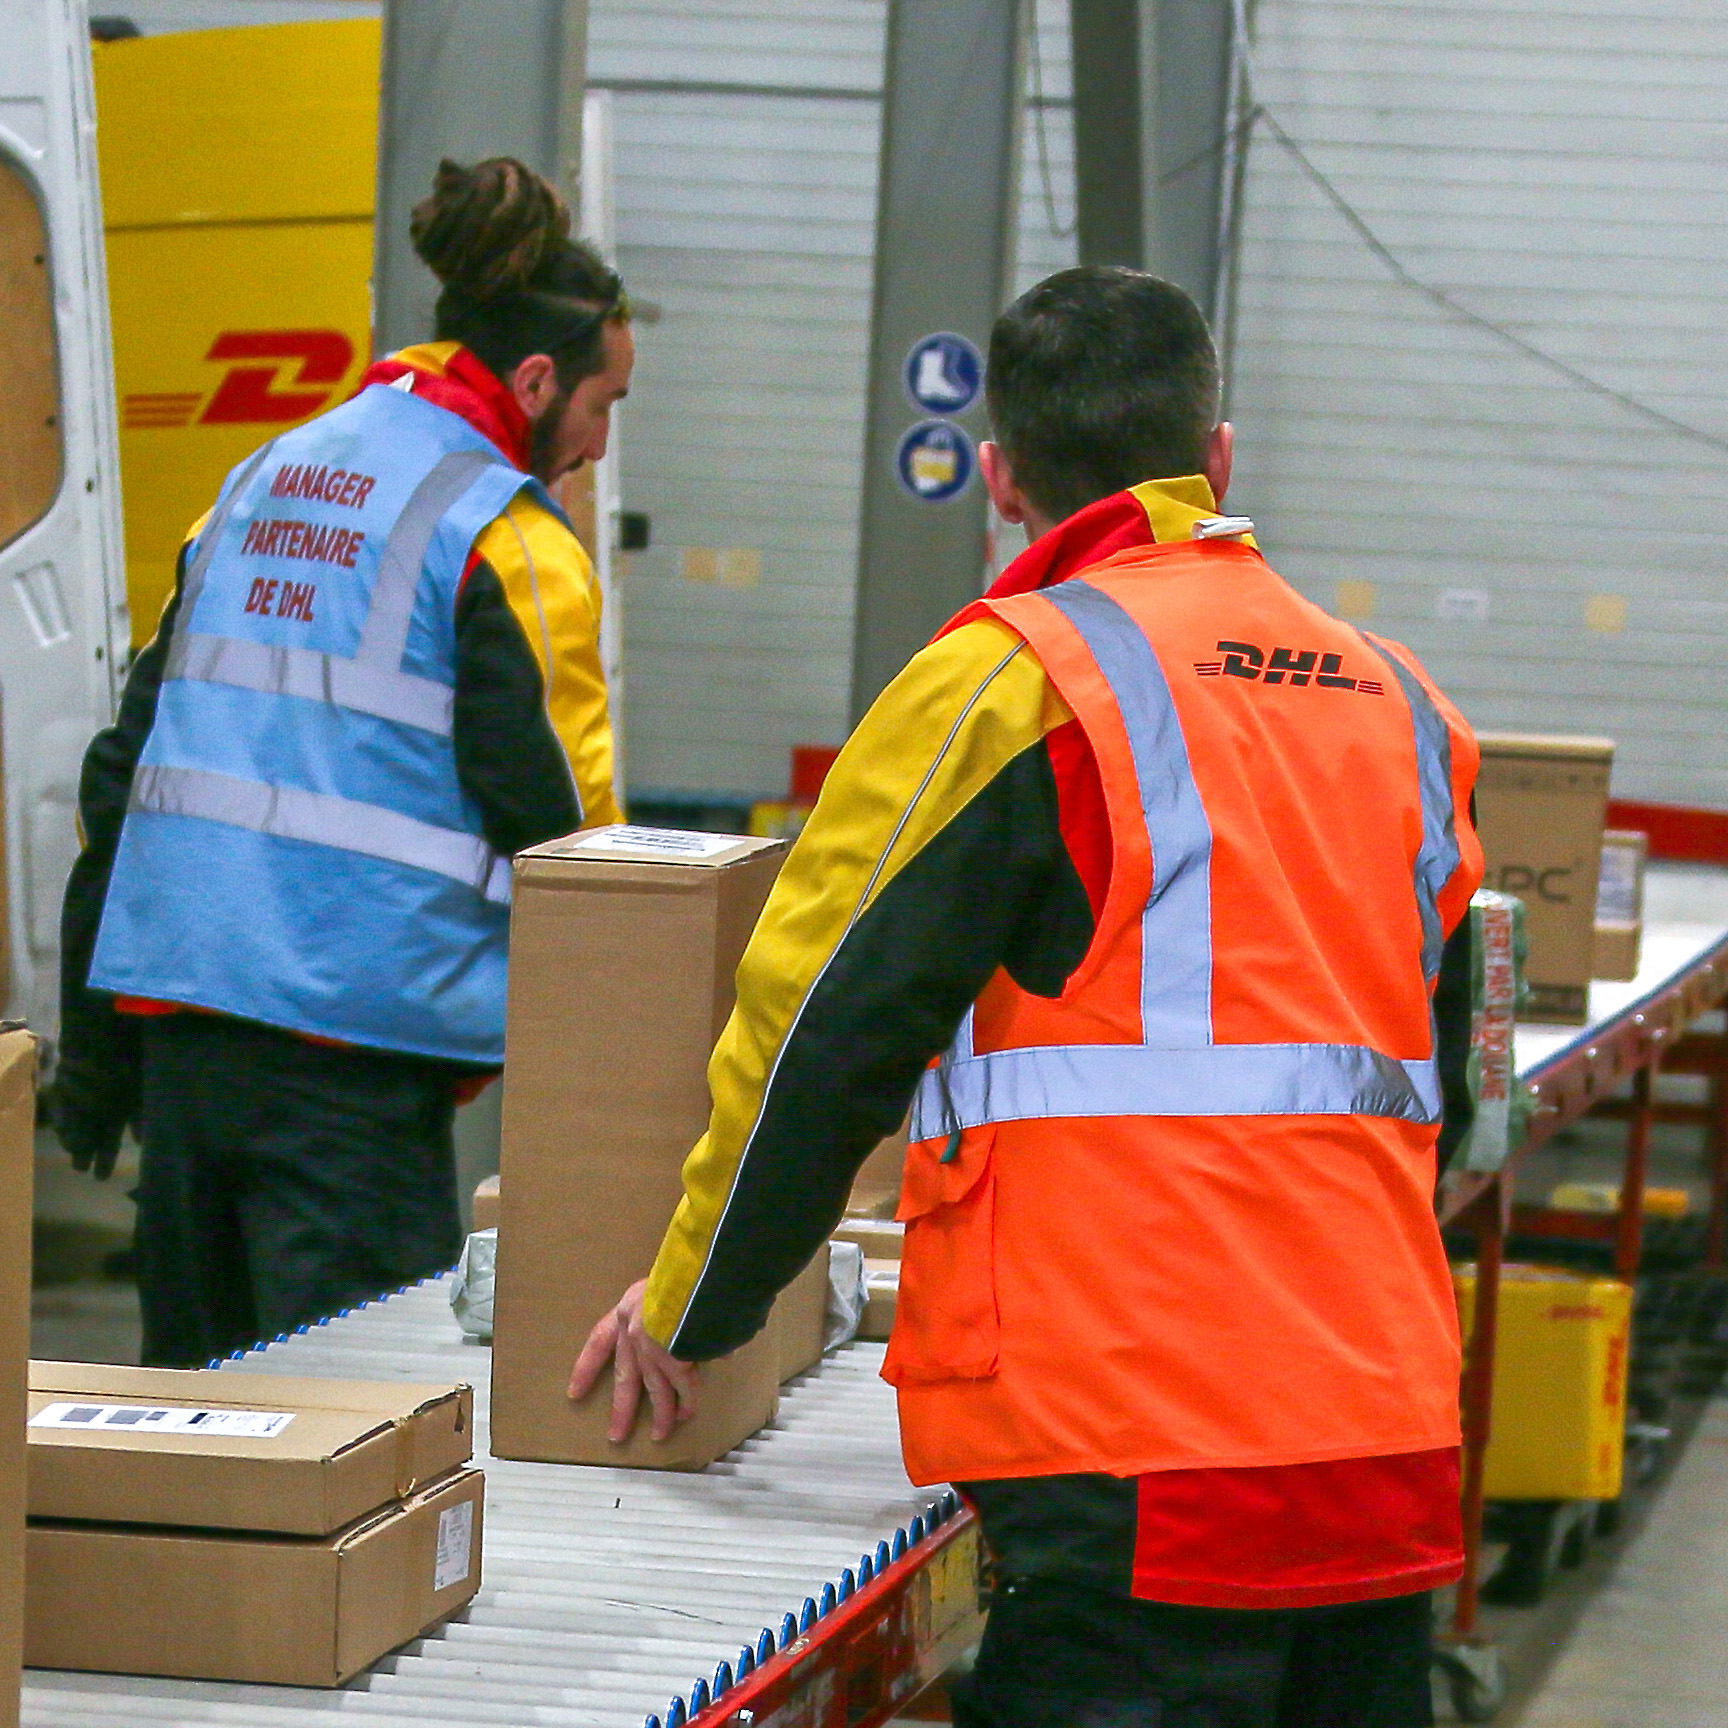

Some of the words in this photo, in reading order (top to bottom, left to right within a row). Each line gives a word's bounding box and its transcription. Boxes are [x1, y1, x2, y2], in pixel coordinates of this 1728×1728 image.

[270, 463, 377, 509] MANAGER
[240, 519, 366, 568] PARTENAIRE
[244, 576, 279, 615] DE
[277, 580, 317, 622] DHL
[1217, 640, 1358, 691] DHL
